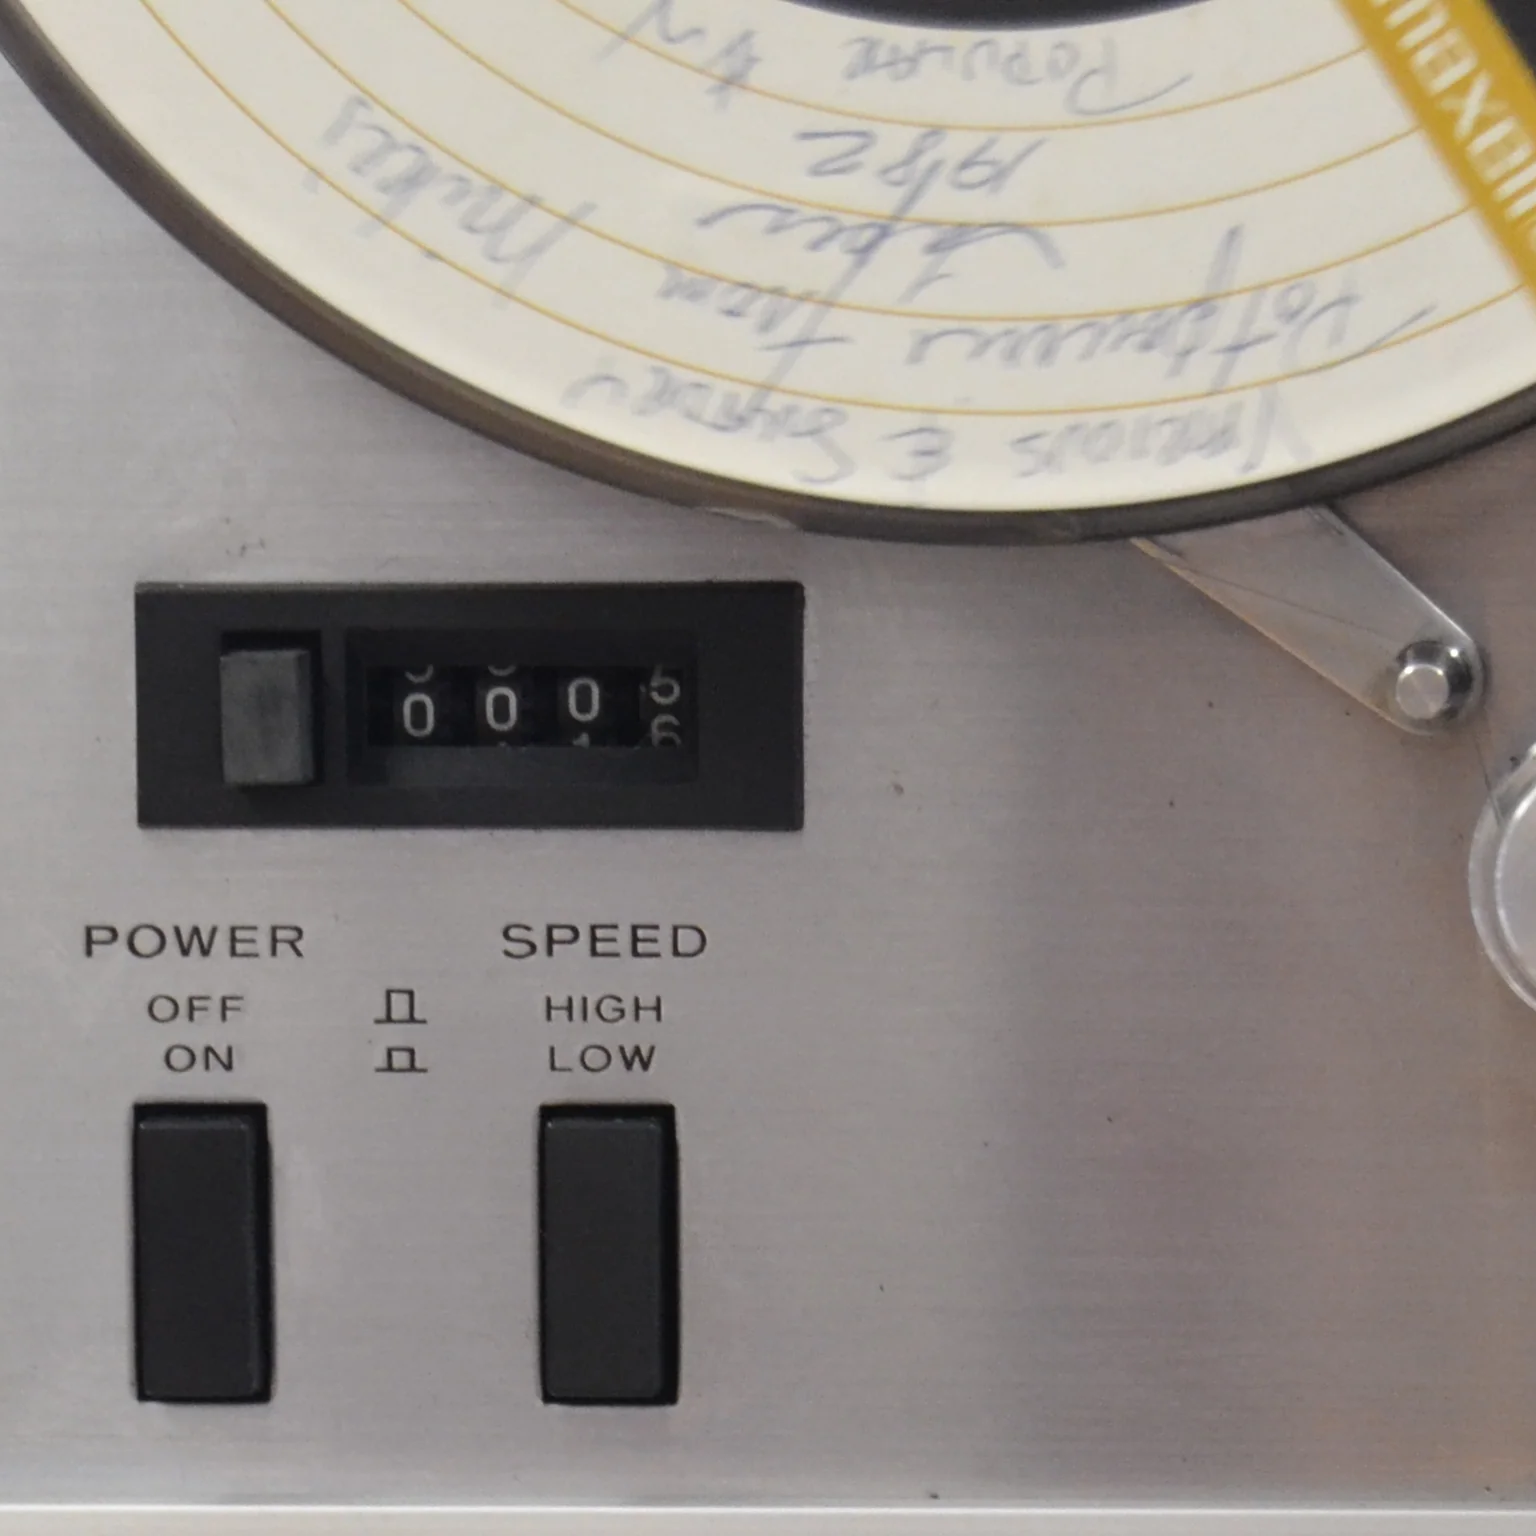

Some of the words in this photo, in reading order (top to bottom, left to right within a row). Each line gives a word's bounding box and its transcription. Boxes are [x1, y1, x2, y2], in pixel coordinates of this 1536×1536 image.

[84, 923, 304, 959] POWER
[502, 923, 707, 960] SPEED
[147, 994, 244, 1024] OFF
[545, 994, 662, 1024] HIGH
[163, 1044, 234, 1073] ON
[549, 1044, 656, 1073] LOW
